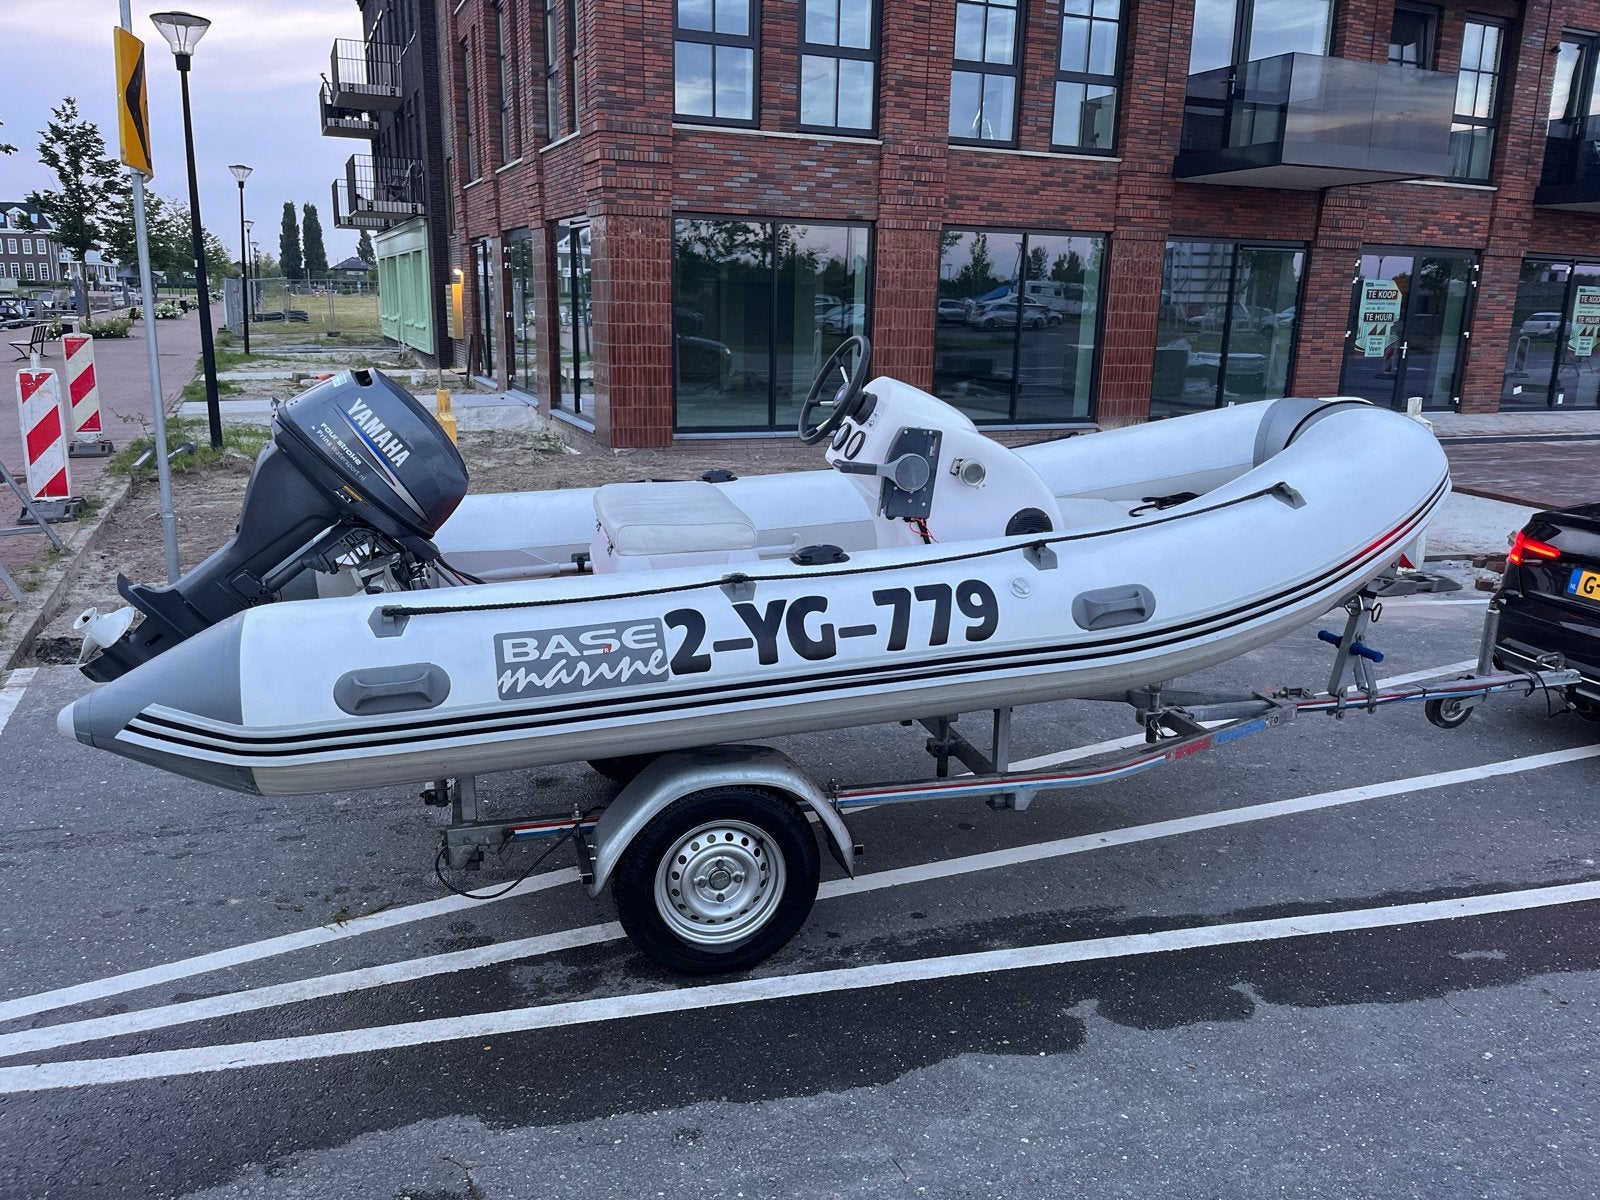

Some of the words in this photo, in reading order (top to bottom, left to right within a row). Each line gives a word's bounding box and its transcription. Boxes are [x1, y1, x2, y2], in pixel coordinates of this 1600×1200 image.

[1368, 290, 1376, 298] TE
[1377, 290, 1397, 299] KOOP
[1366, 313, 1374, 321] TE
[1374, 313, 1393, 322] HUUR
[346, 397, 411, 468] YAMAHA
[502, 622, 658, 664] BASE
[664, 578, 999, 676] 2-YG-779
[498, 648, 670, 692] marine
